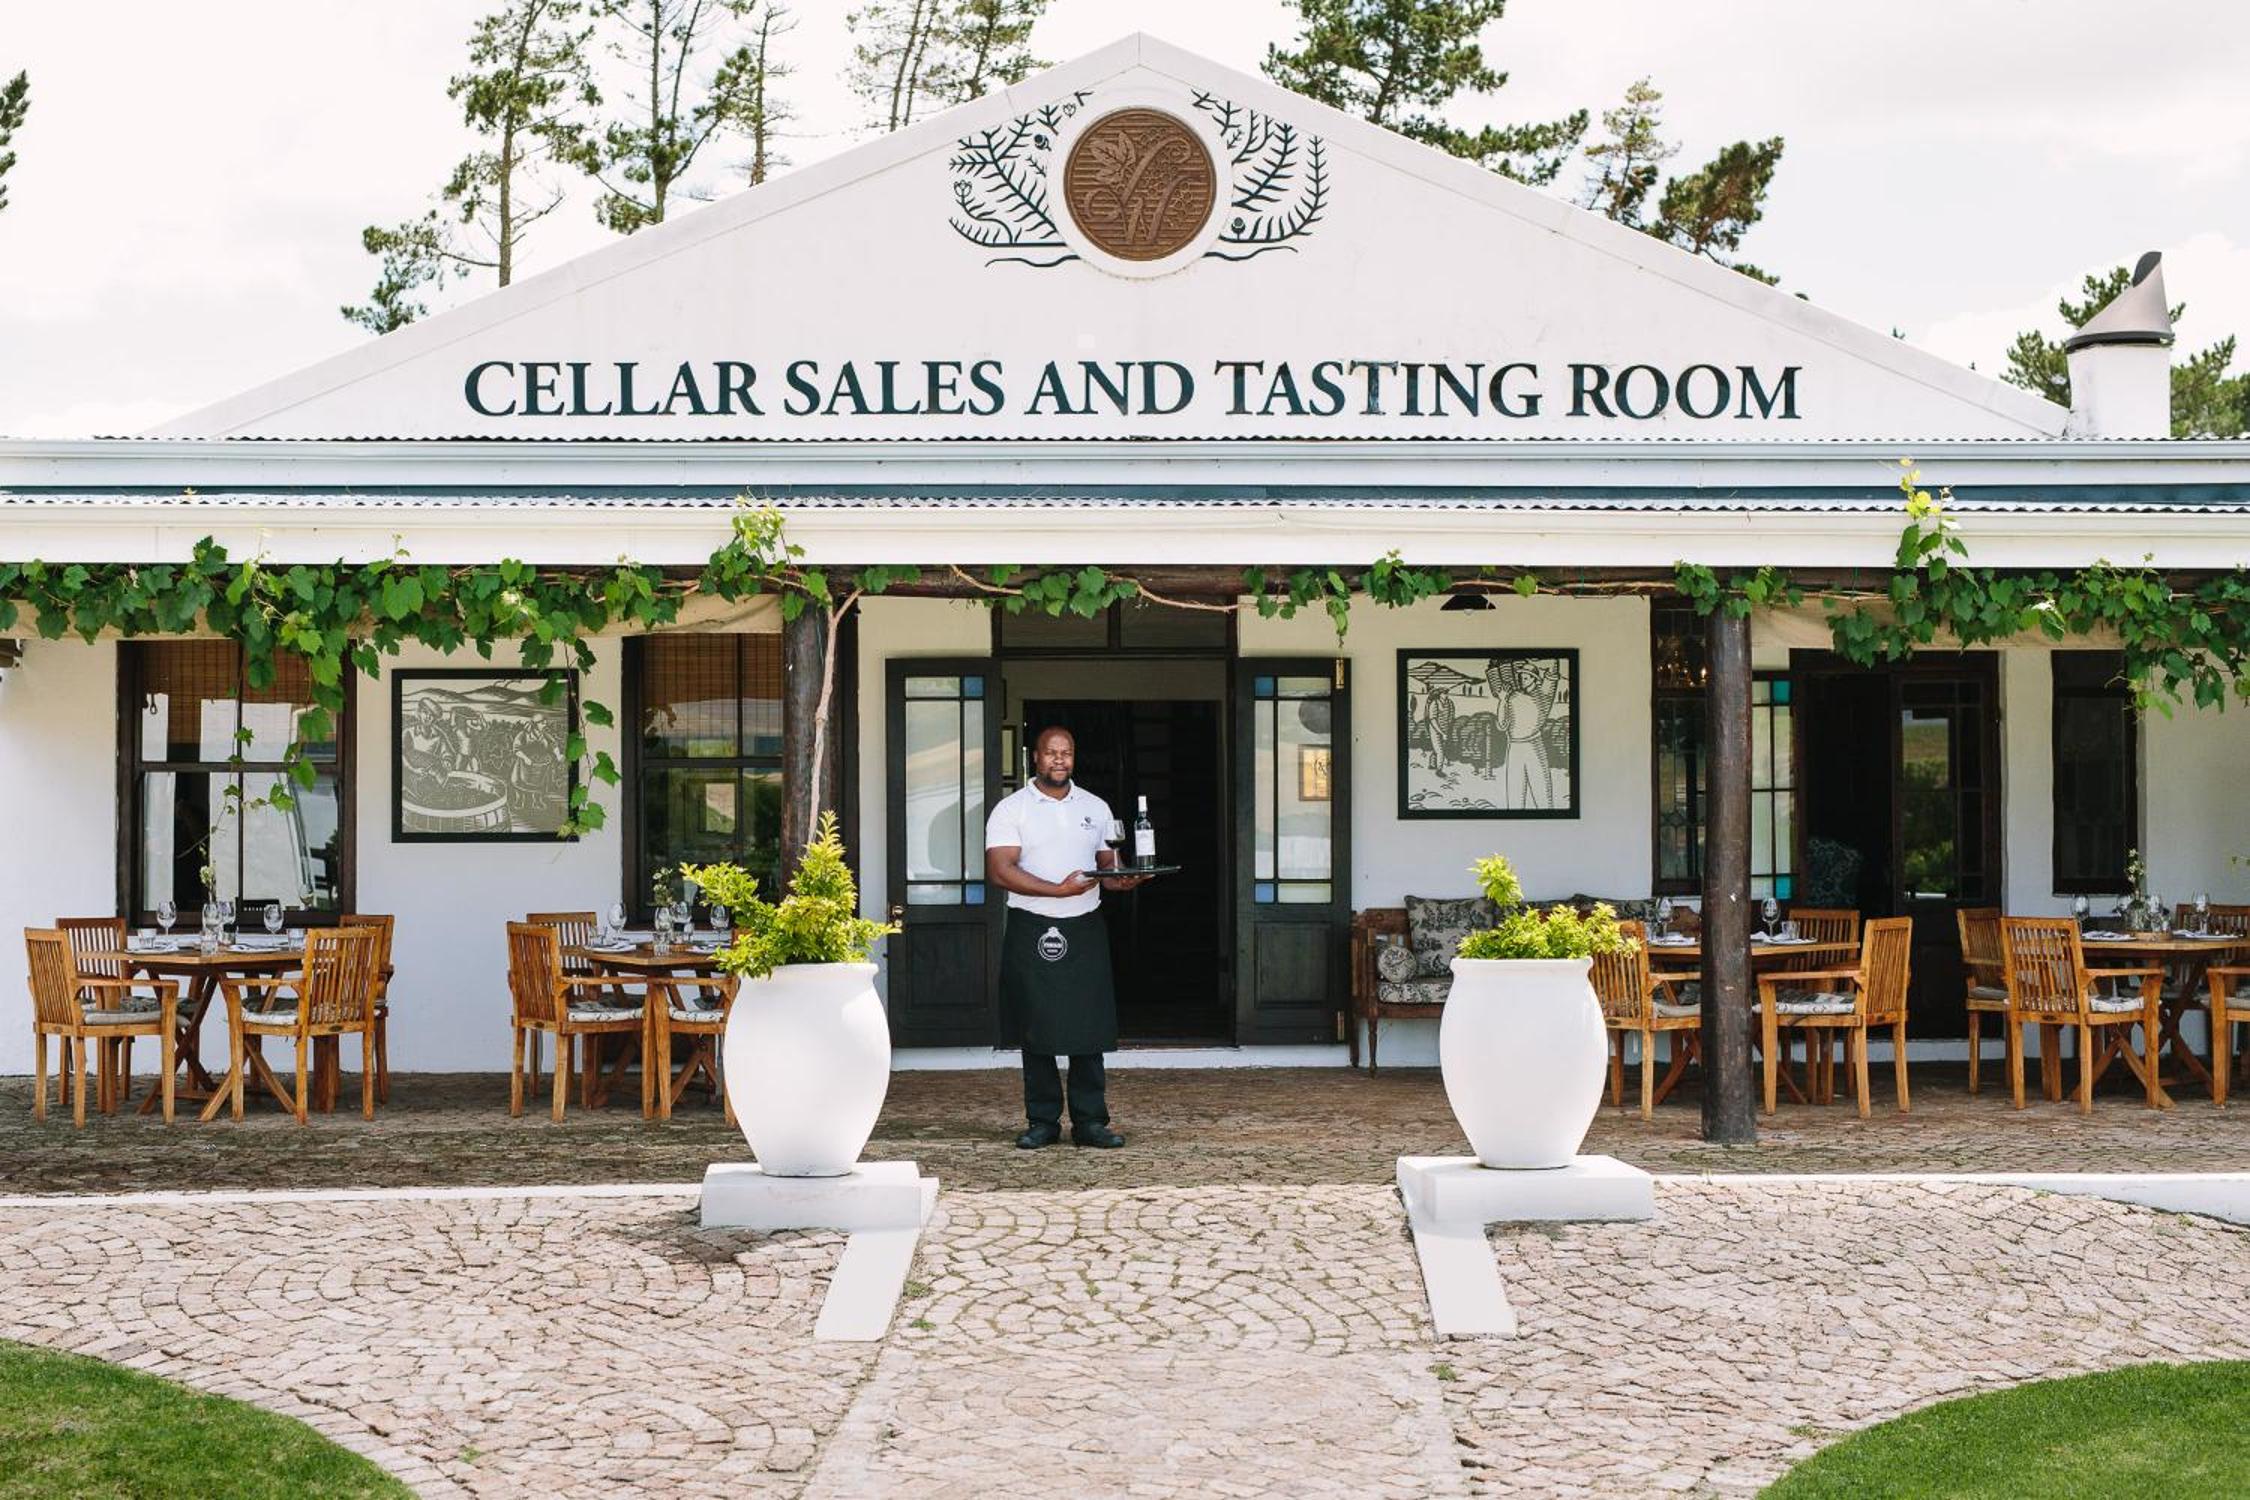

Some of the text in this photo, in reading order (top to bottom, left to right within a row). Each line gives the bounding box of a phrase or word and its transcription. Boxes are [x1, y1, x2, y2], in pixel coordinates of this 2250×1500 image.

[465, 360, 1803, 419] CELLAR SALES AND TASTING ROOM
